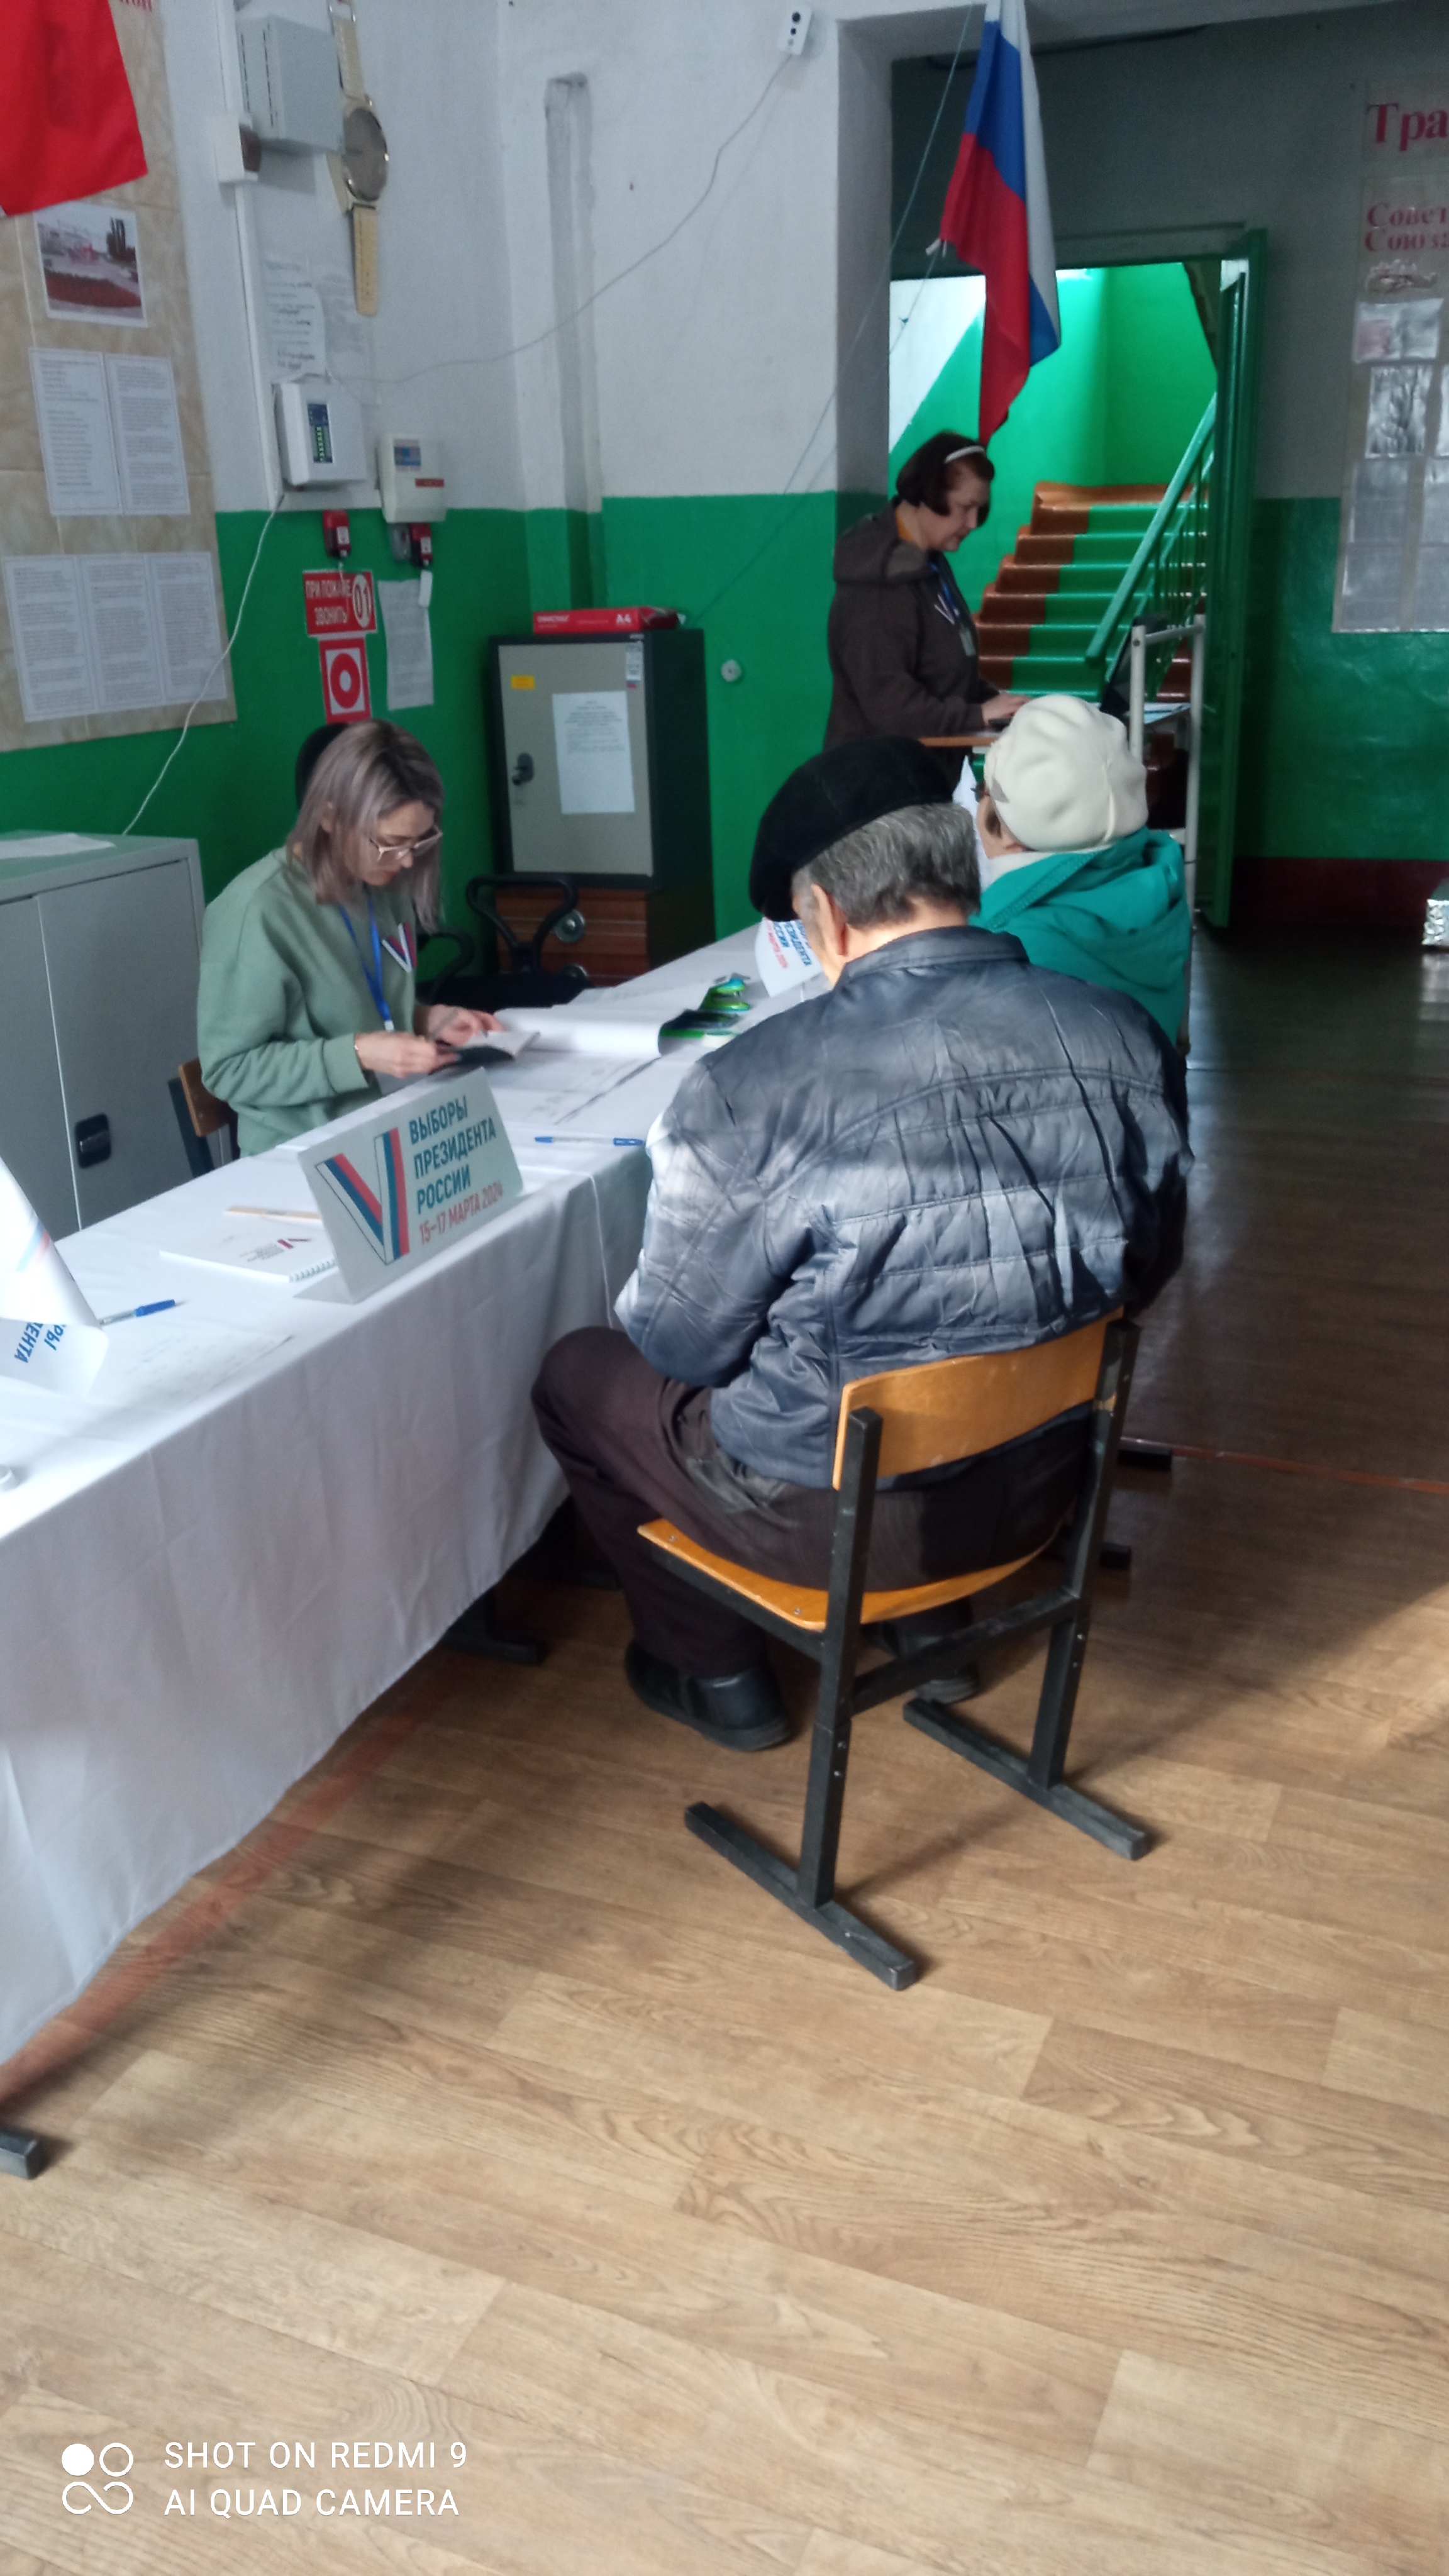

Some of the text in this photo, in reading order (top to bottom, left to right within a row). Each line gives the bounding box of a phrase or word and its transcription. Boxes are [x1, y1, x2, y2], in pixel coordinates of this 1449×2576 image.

[1367, 103, 1449, 152] Тра
[408, 1095, 469, 1146] ВЫБОРЫ
[413, 1116, 497, 1180] ПРЕЗИДЕНТА
[416, 1163, 471, 1216] РОССИИ
[448, 1193, 480, 1229] МАРТА
[482, 1180, 504, 1209] 2024
